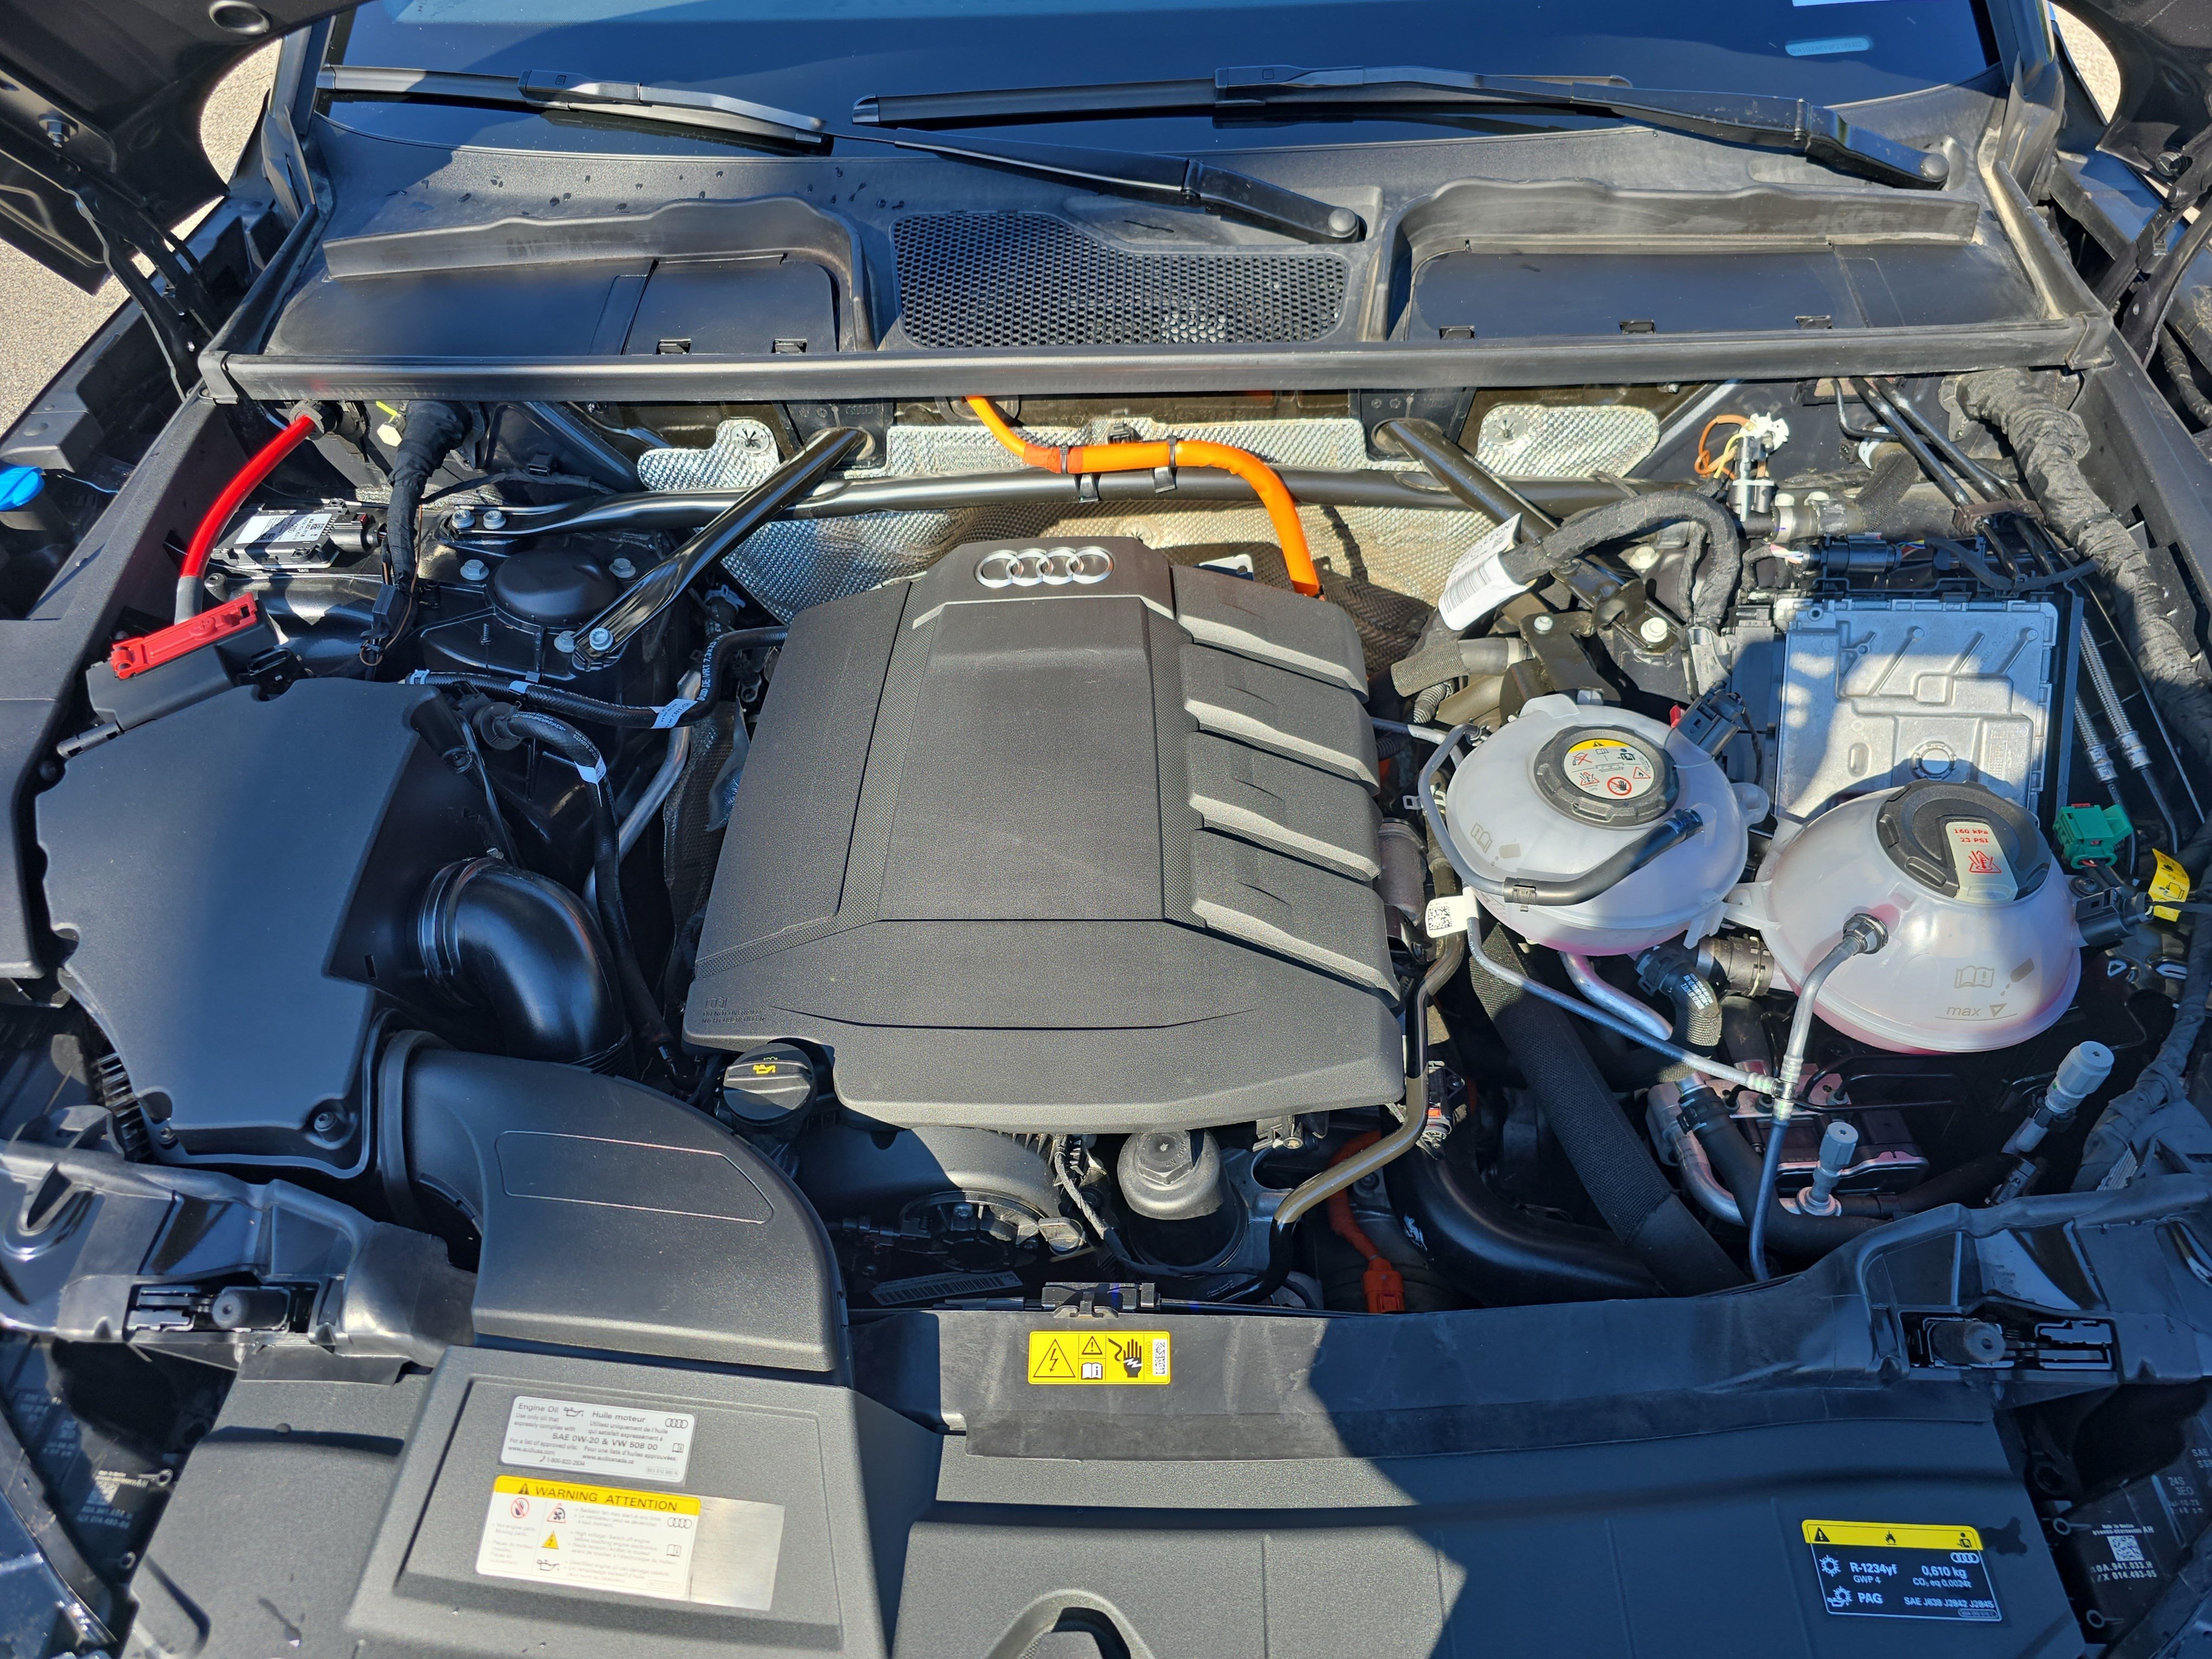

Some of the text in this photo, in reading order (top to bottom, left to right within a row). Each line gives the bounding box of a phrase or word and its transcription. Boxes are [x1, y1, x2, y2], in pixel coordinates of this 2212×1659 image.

[1484, 522, 1513, 544] LEONI
[1946, 1007, 1982, 1017] max
[518, 1402, 559, 1413] Engine Oil
[592, 1410, 646, 1423] Huile moteur
[552, 1432, 570, 1441] SAE
[571, 1435, 599, 1444] 0W-20
[611, 1439, 627, 1447] VW
[534, 1486, 677, 1512] WARNING ATTENTION
[2143, 1525, 2155, 1534] AH
[1848, 1561, 1900, 1577] R-1234yf
[1920, 1565, 1968, 1579] 0,610 kg
[1852, 1575, 1882, 1584] GWP 4
[1929, 1579, 1941, 1588] eq
[1856, 1592, 1884, 1604] PAG
[1902, 1596, 1923, 1606] SAE
